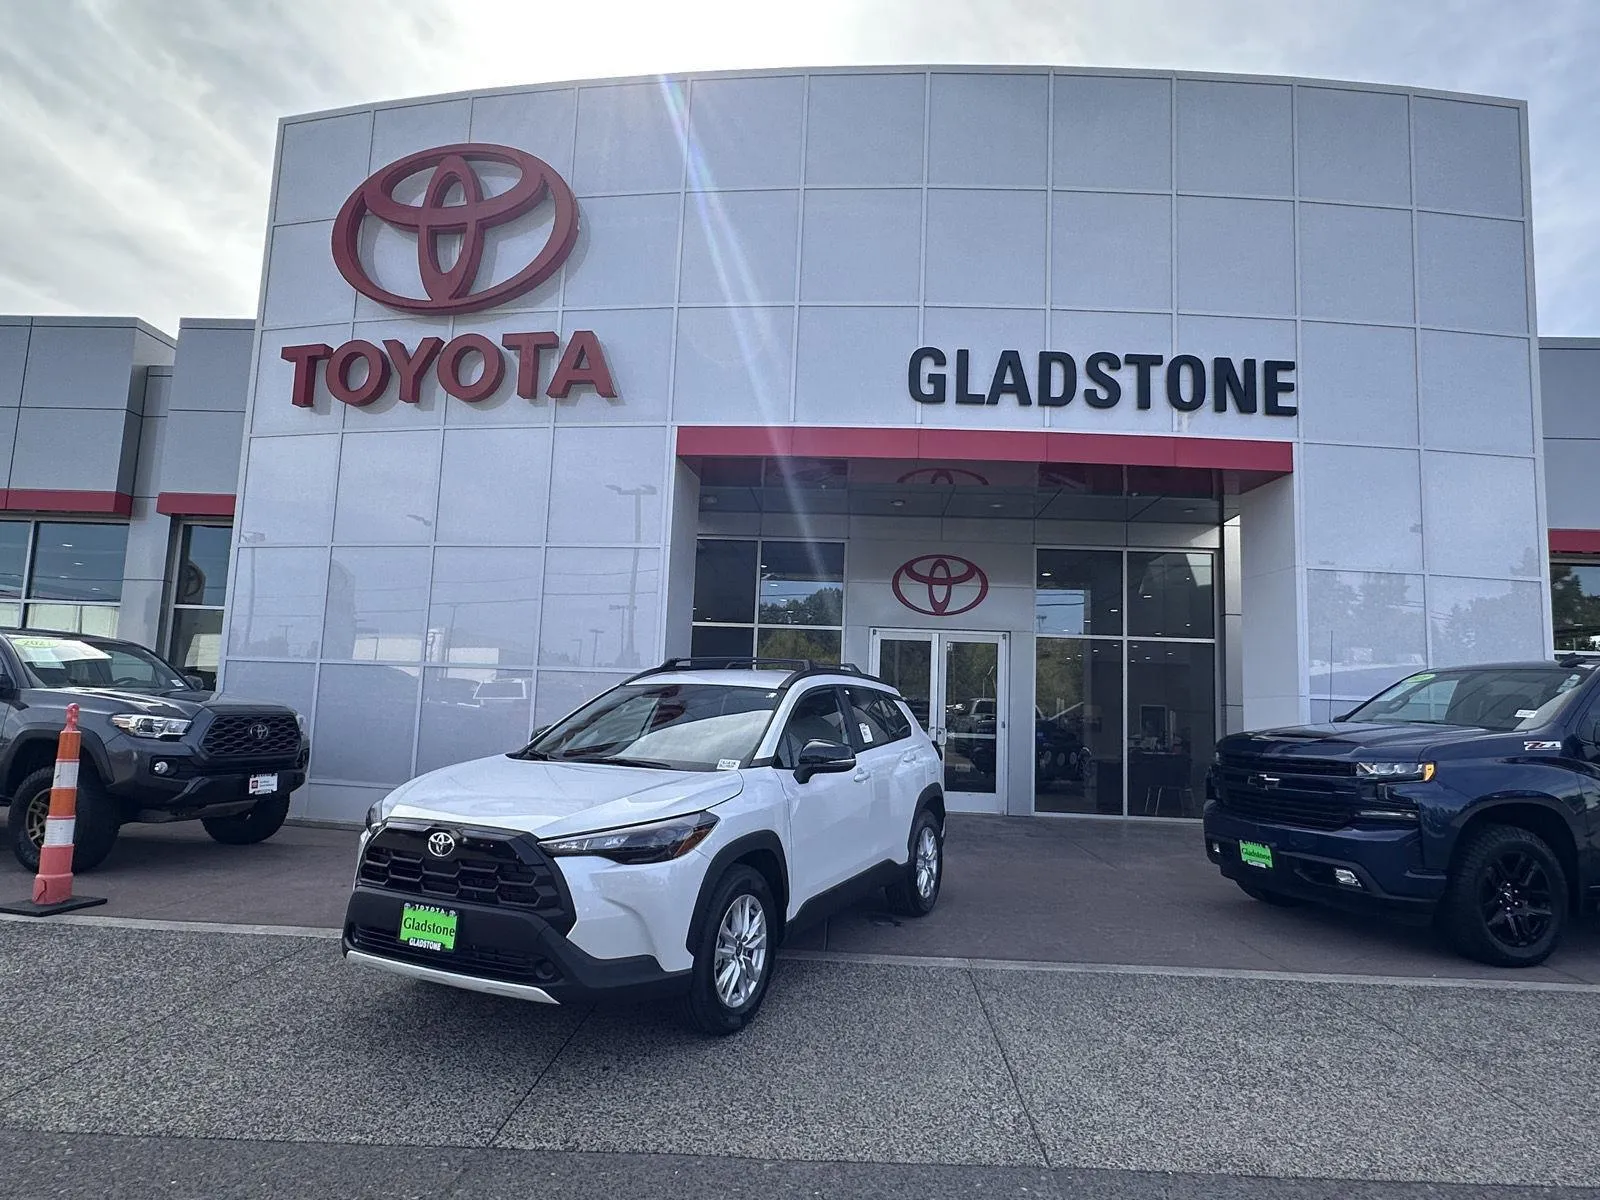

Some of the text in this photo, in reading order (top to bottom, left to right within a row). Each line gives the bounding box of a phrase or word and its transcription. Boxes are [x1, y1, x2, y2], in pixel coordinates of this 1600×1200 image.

[281, 330, 618, 408] TOYOTA
[908, 346, 1298, 417] GLADSTONE
[415, 904, 445, 914] TOYOTA
[403, 917, 455, 937] Gladstone
[409, 938, 441, 951] GLADSTONE
